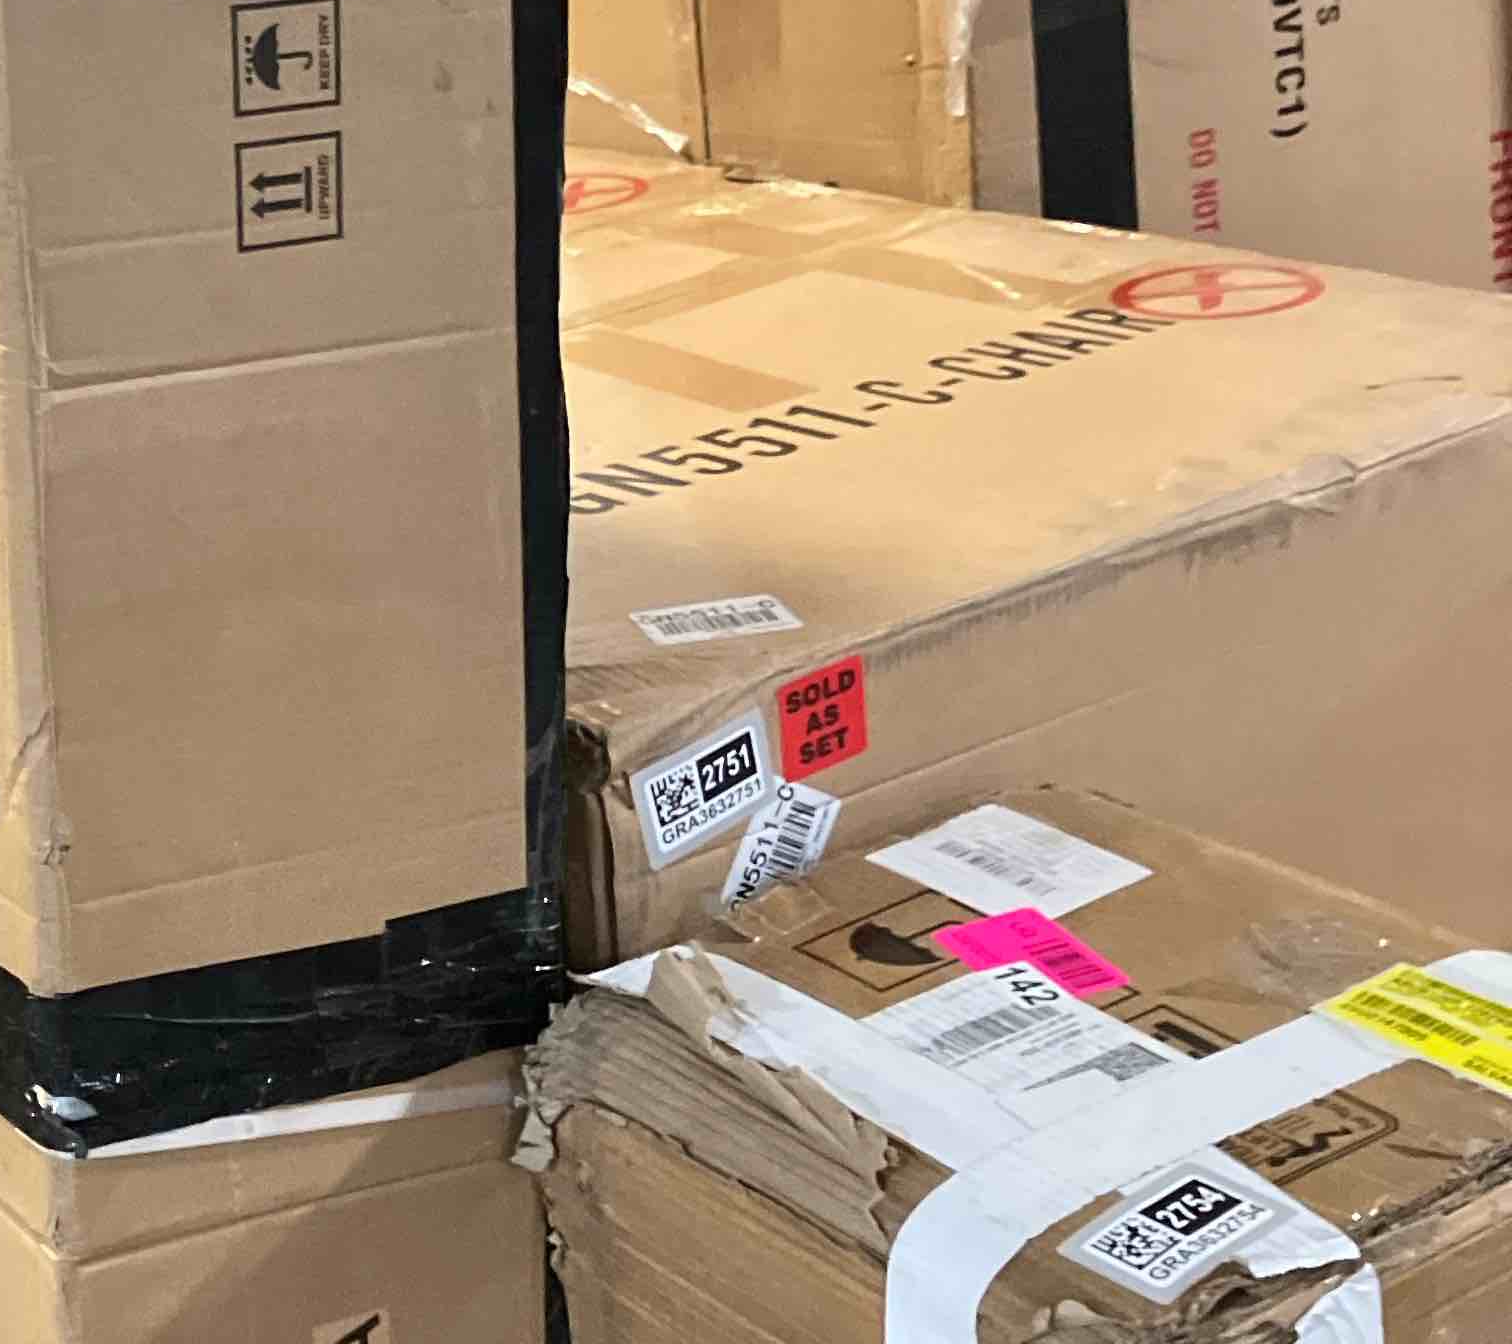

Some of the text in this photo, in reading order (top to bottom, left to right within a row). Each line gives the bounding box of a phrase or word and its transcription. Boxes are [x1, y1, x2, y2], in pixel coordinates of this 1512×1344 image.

[317, 14, 331, 91] KEEP DRY
[785, 668, 856, 714] SOLD
[805, 704, 841, 735] AS
[701, 743, 752, 792] 2751
[798, 726, 850, 766] SET
[661, 778, 762, 846] GRA3632751
[994, 966, 1060, 1007] 142
[1155, 1185, 1226, 1229] 2754
